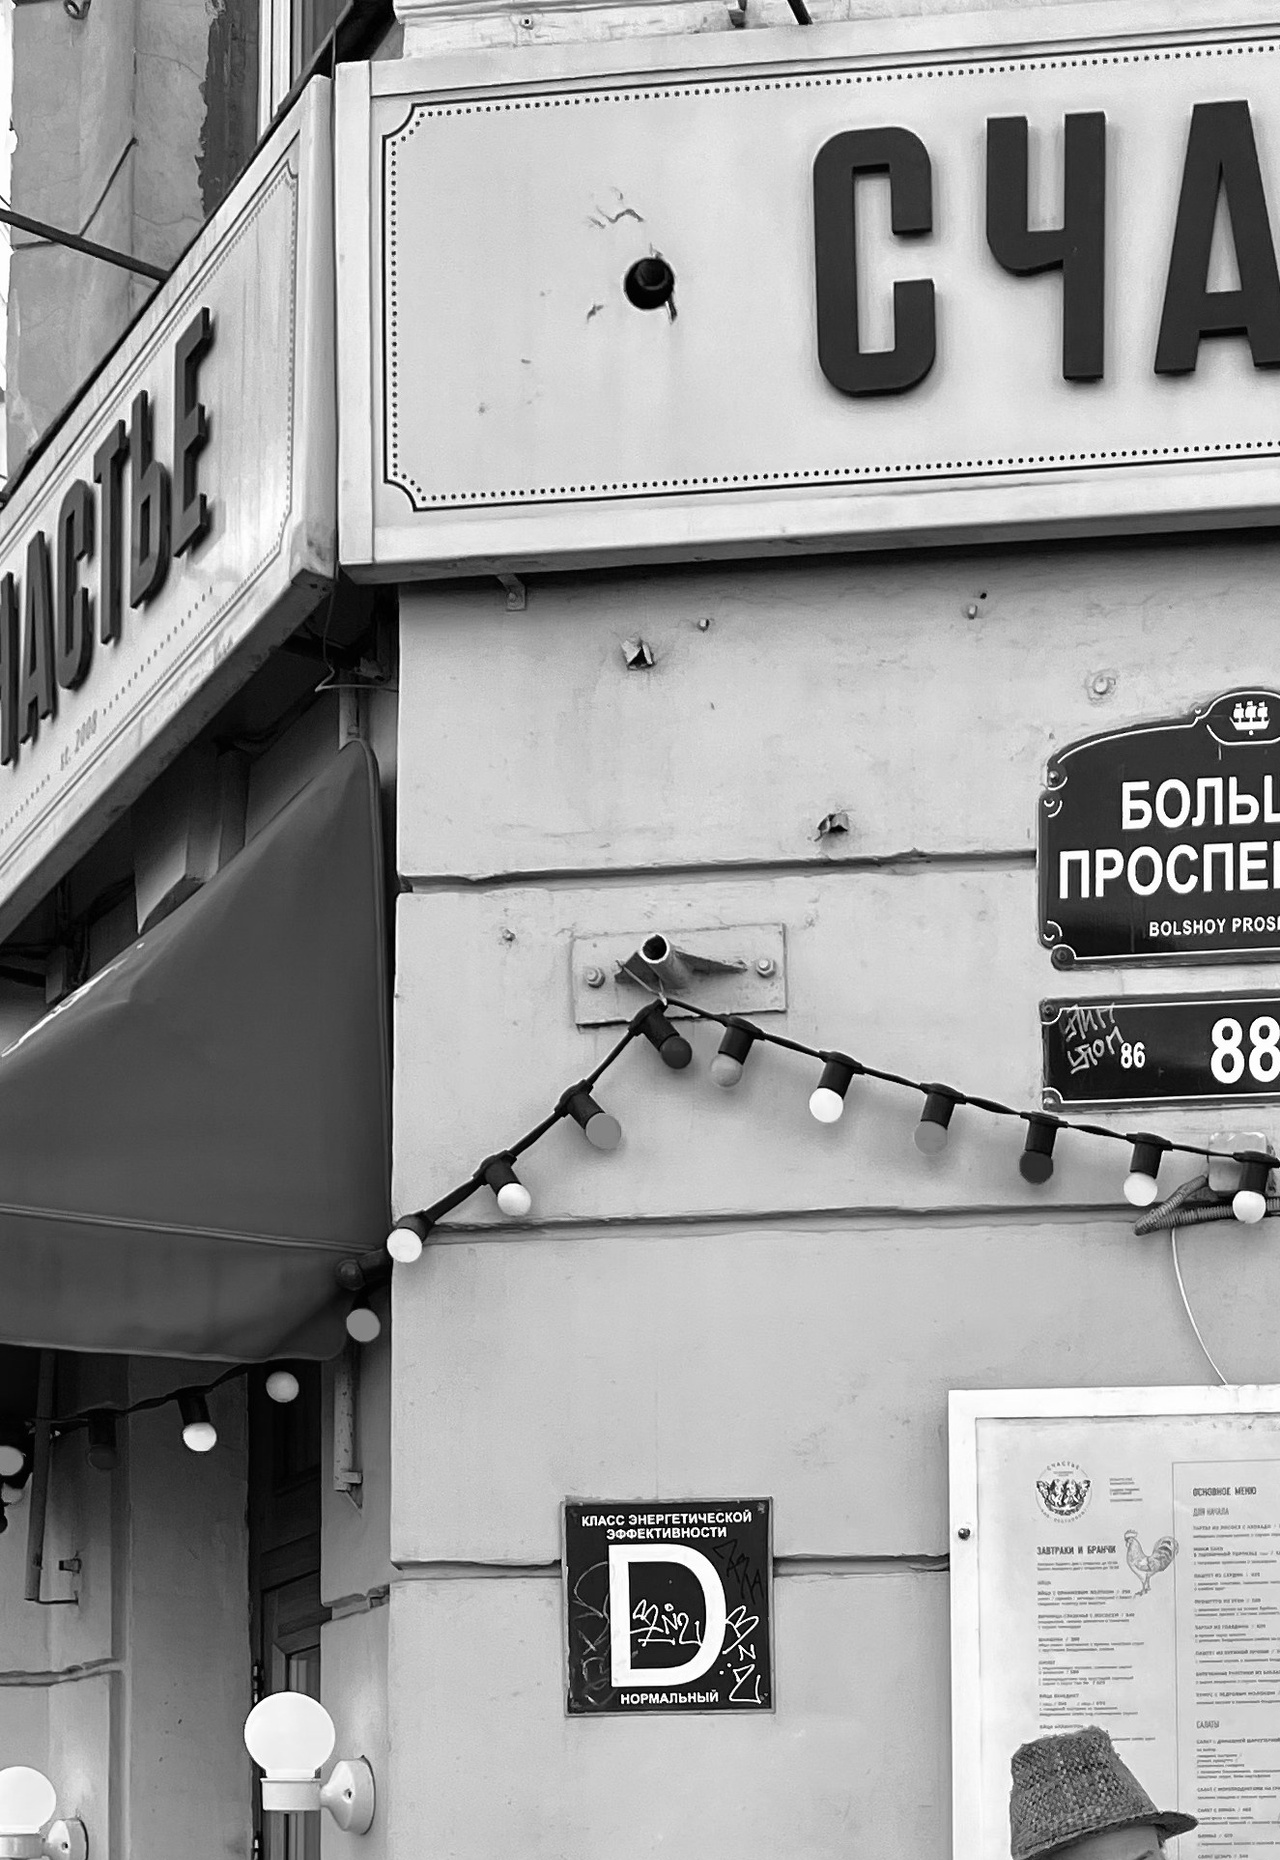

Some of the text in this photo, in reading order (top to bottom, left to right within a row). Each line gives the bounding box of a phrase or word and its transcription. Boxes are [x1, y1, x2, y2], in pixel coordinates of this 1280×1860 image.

[1149, 918, 1226, 937] BOLSHOY
[1120, 1041, 1146, 1069] 86
[581, 1509, 752, 1527] КЛАСС ЭНЕРГЕТИЧЕСКОЙ
[606, 1527, 727, 1540] ЭФФЕКТИВНОСТИ
[608, 1543, 727, 1687] D
[620, 1690, 719, 1705] НОРМАЛЬНЫЙ
